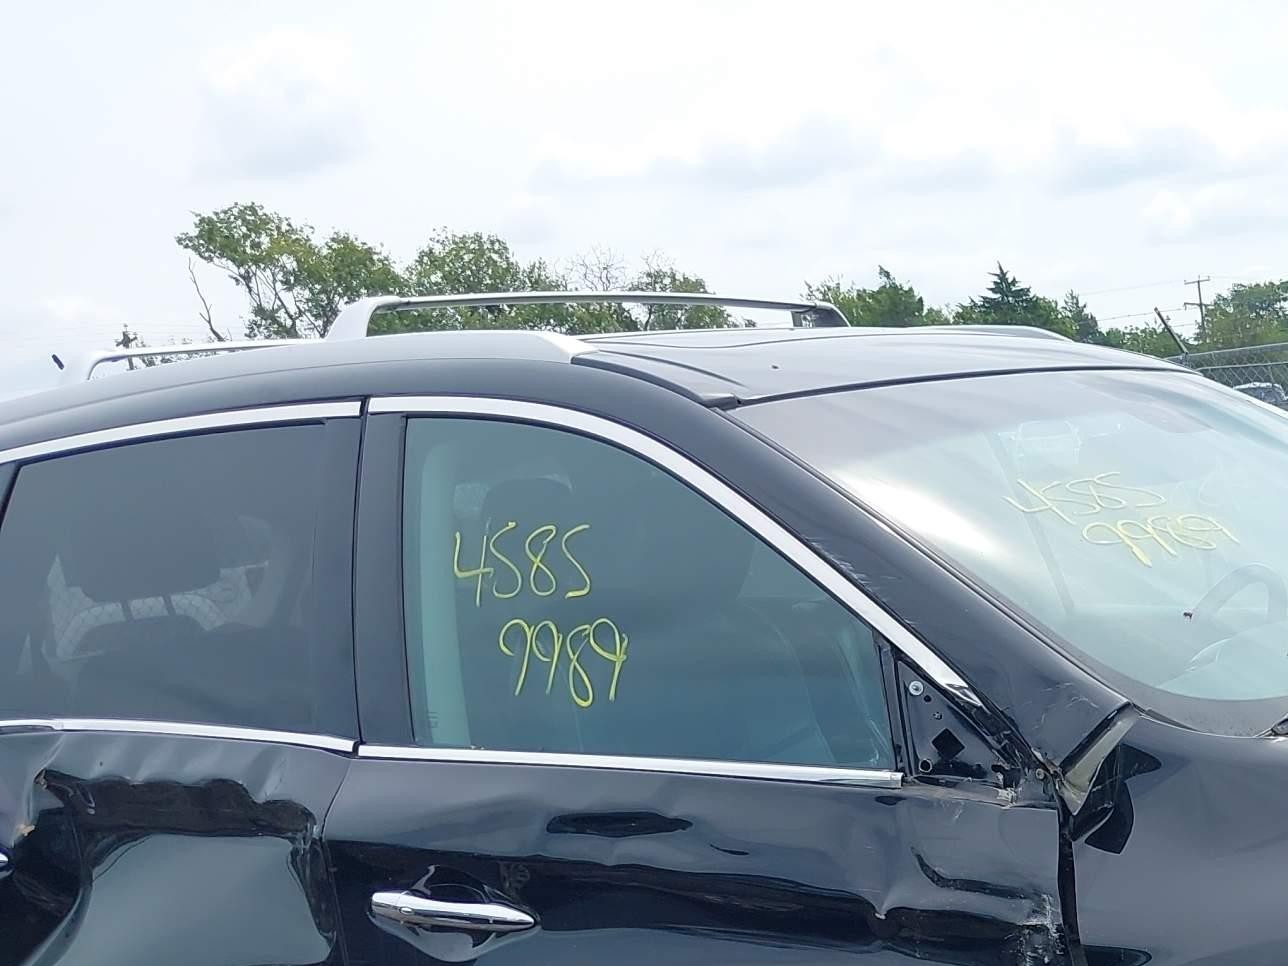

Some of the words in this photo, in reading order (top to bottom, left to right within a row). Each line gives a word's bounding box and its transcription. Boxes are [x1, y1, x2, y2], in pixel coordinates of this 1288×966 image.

[1002, 471, 1167, 526] 4585
[453, 518, 591, 607] 4585
[498, 617, 629, 708] 9989
